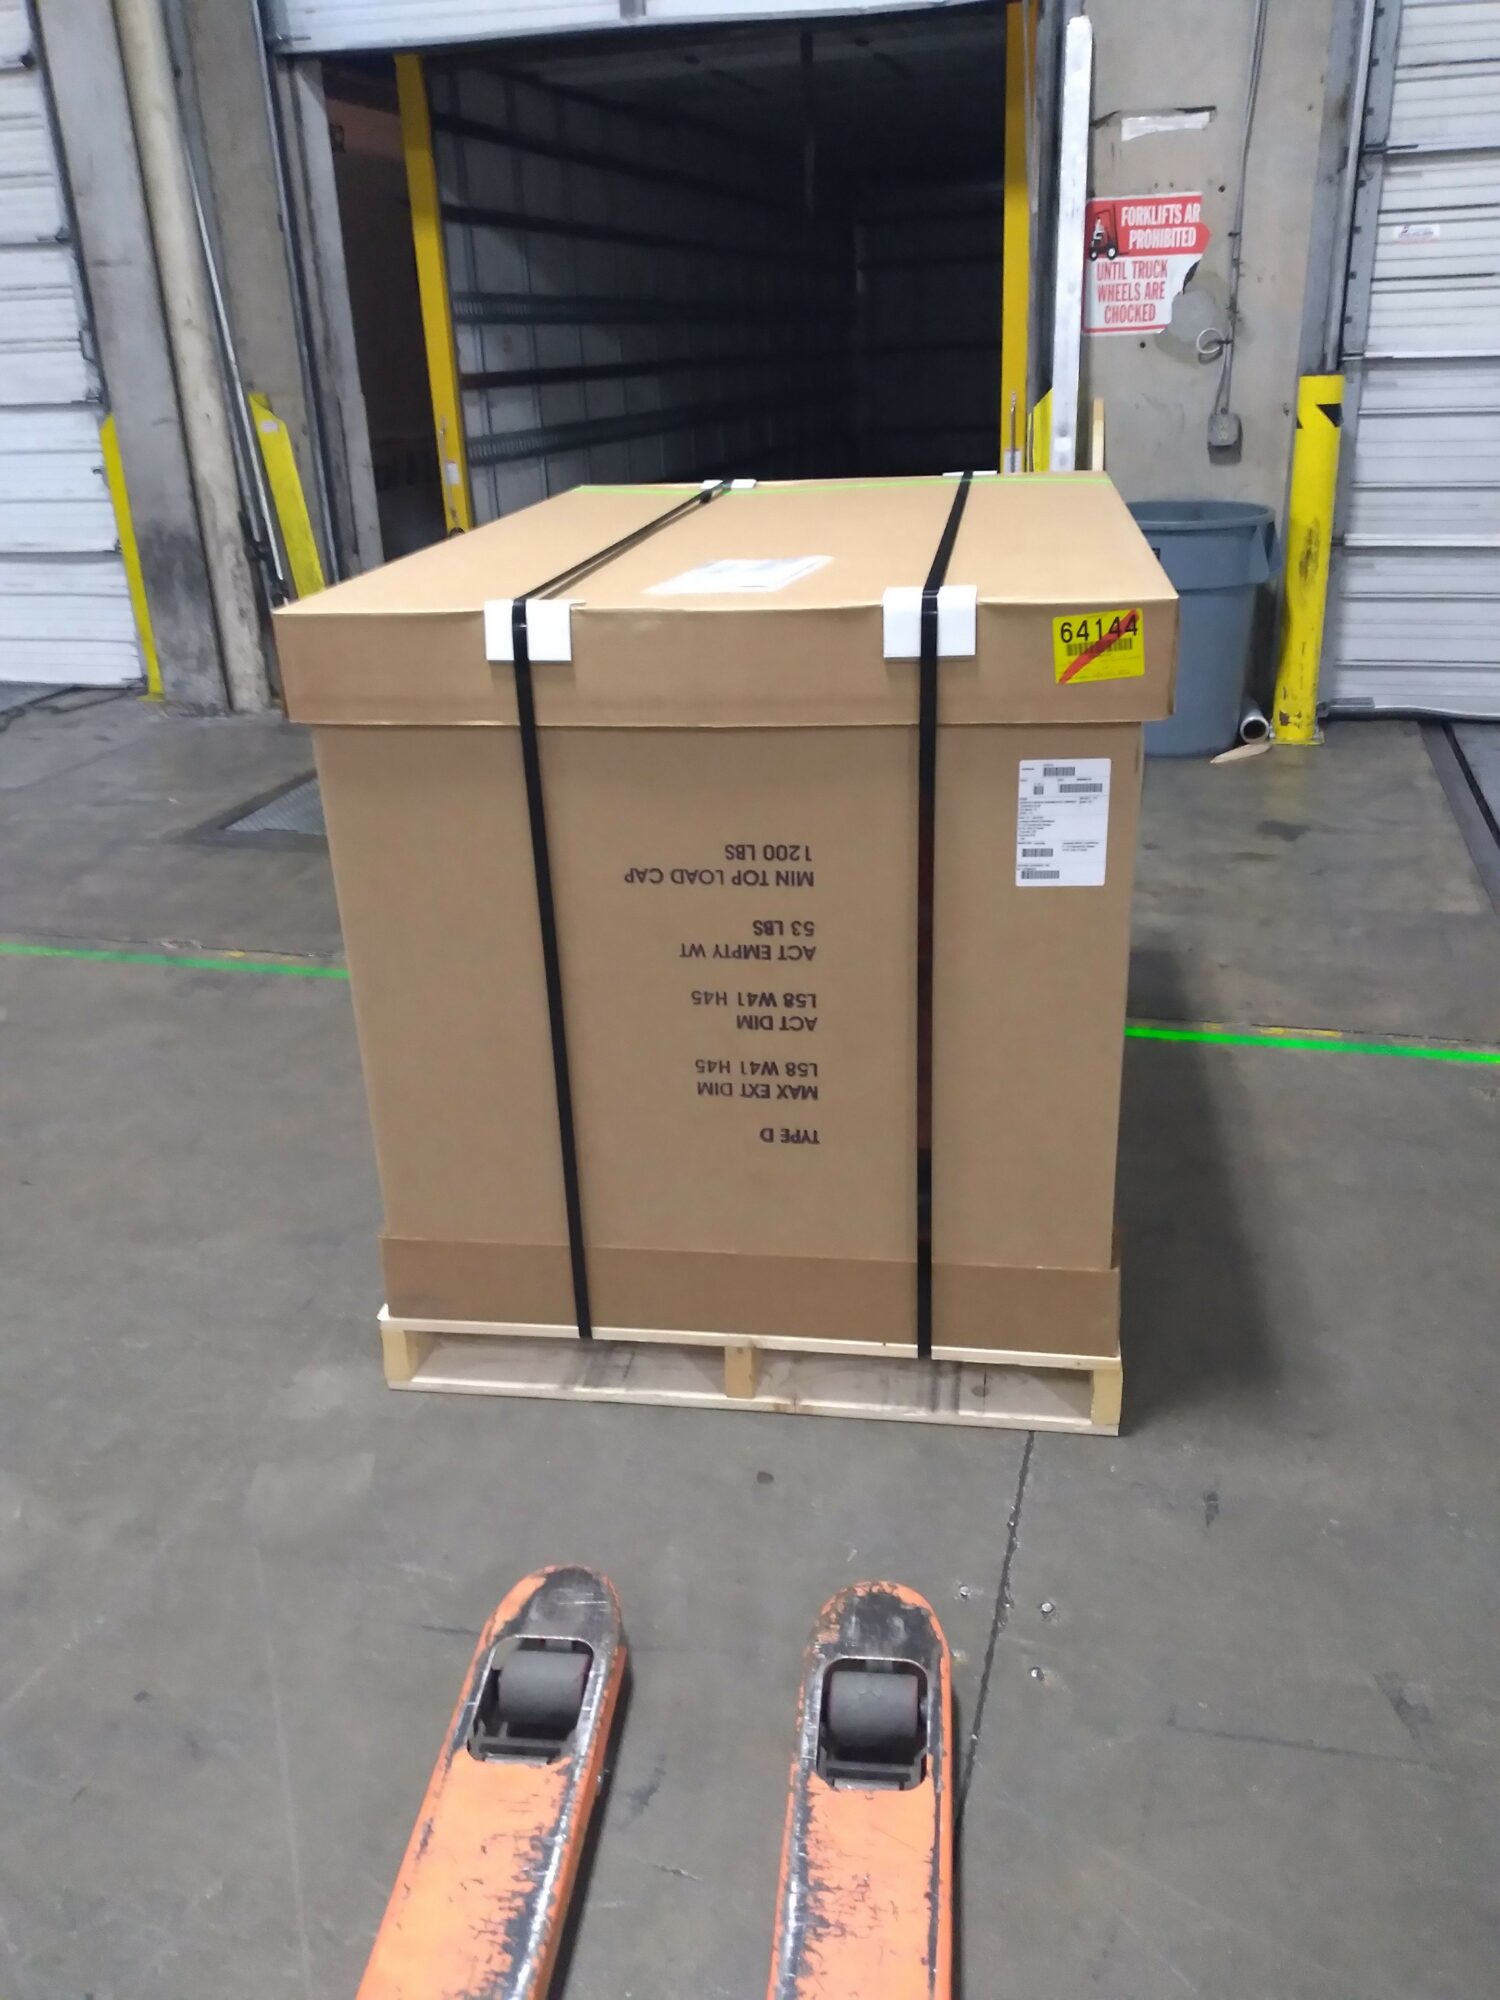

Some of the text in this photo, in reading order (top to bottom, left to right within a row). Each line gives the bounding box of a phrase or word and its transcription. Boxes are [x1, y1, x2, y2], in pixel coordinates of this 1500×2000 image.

[1121, 203, 1201, 226] FORKLIFTS AR
[1129, 227, 1196, 249] PROHIBITED
[1096, 260, 1168, 281] UNTIL TRUCK
[1097, 281, 1166, 302] WHEELS ARE
[1104, 304, 1156, 323] CHOCKED
[1060, 614, 1138, 643] 64144
[725, 844, 812, 861] 1200 LBS
[624, 868, 814, 887] MIN TOP LOAD CAP
[752, 920, 815, 936] 53 LBS
[679, 943, 816, 961] ACT EMPTY WT
[691, 990, 817, 1008] L58 W41 H45
[736, 1015, 818, 1031] ACT DIM
[695, 1059, 818, 1078] L58 W41 H45
[697, 1082, 819, 1100] MAX EXT DIM
[759, 1127, 820, 1144] TYPE D
